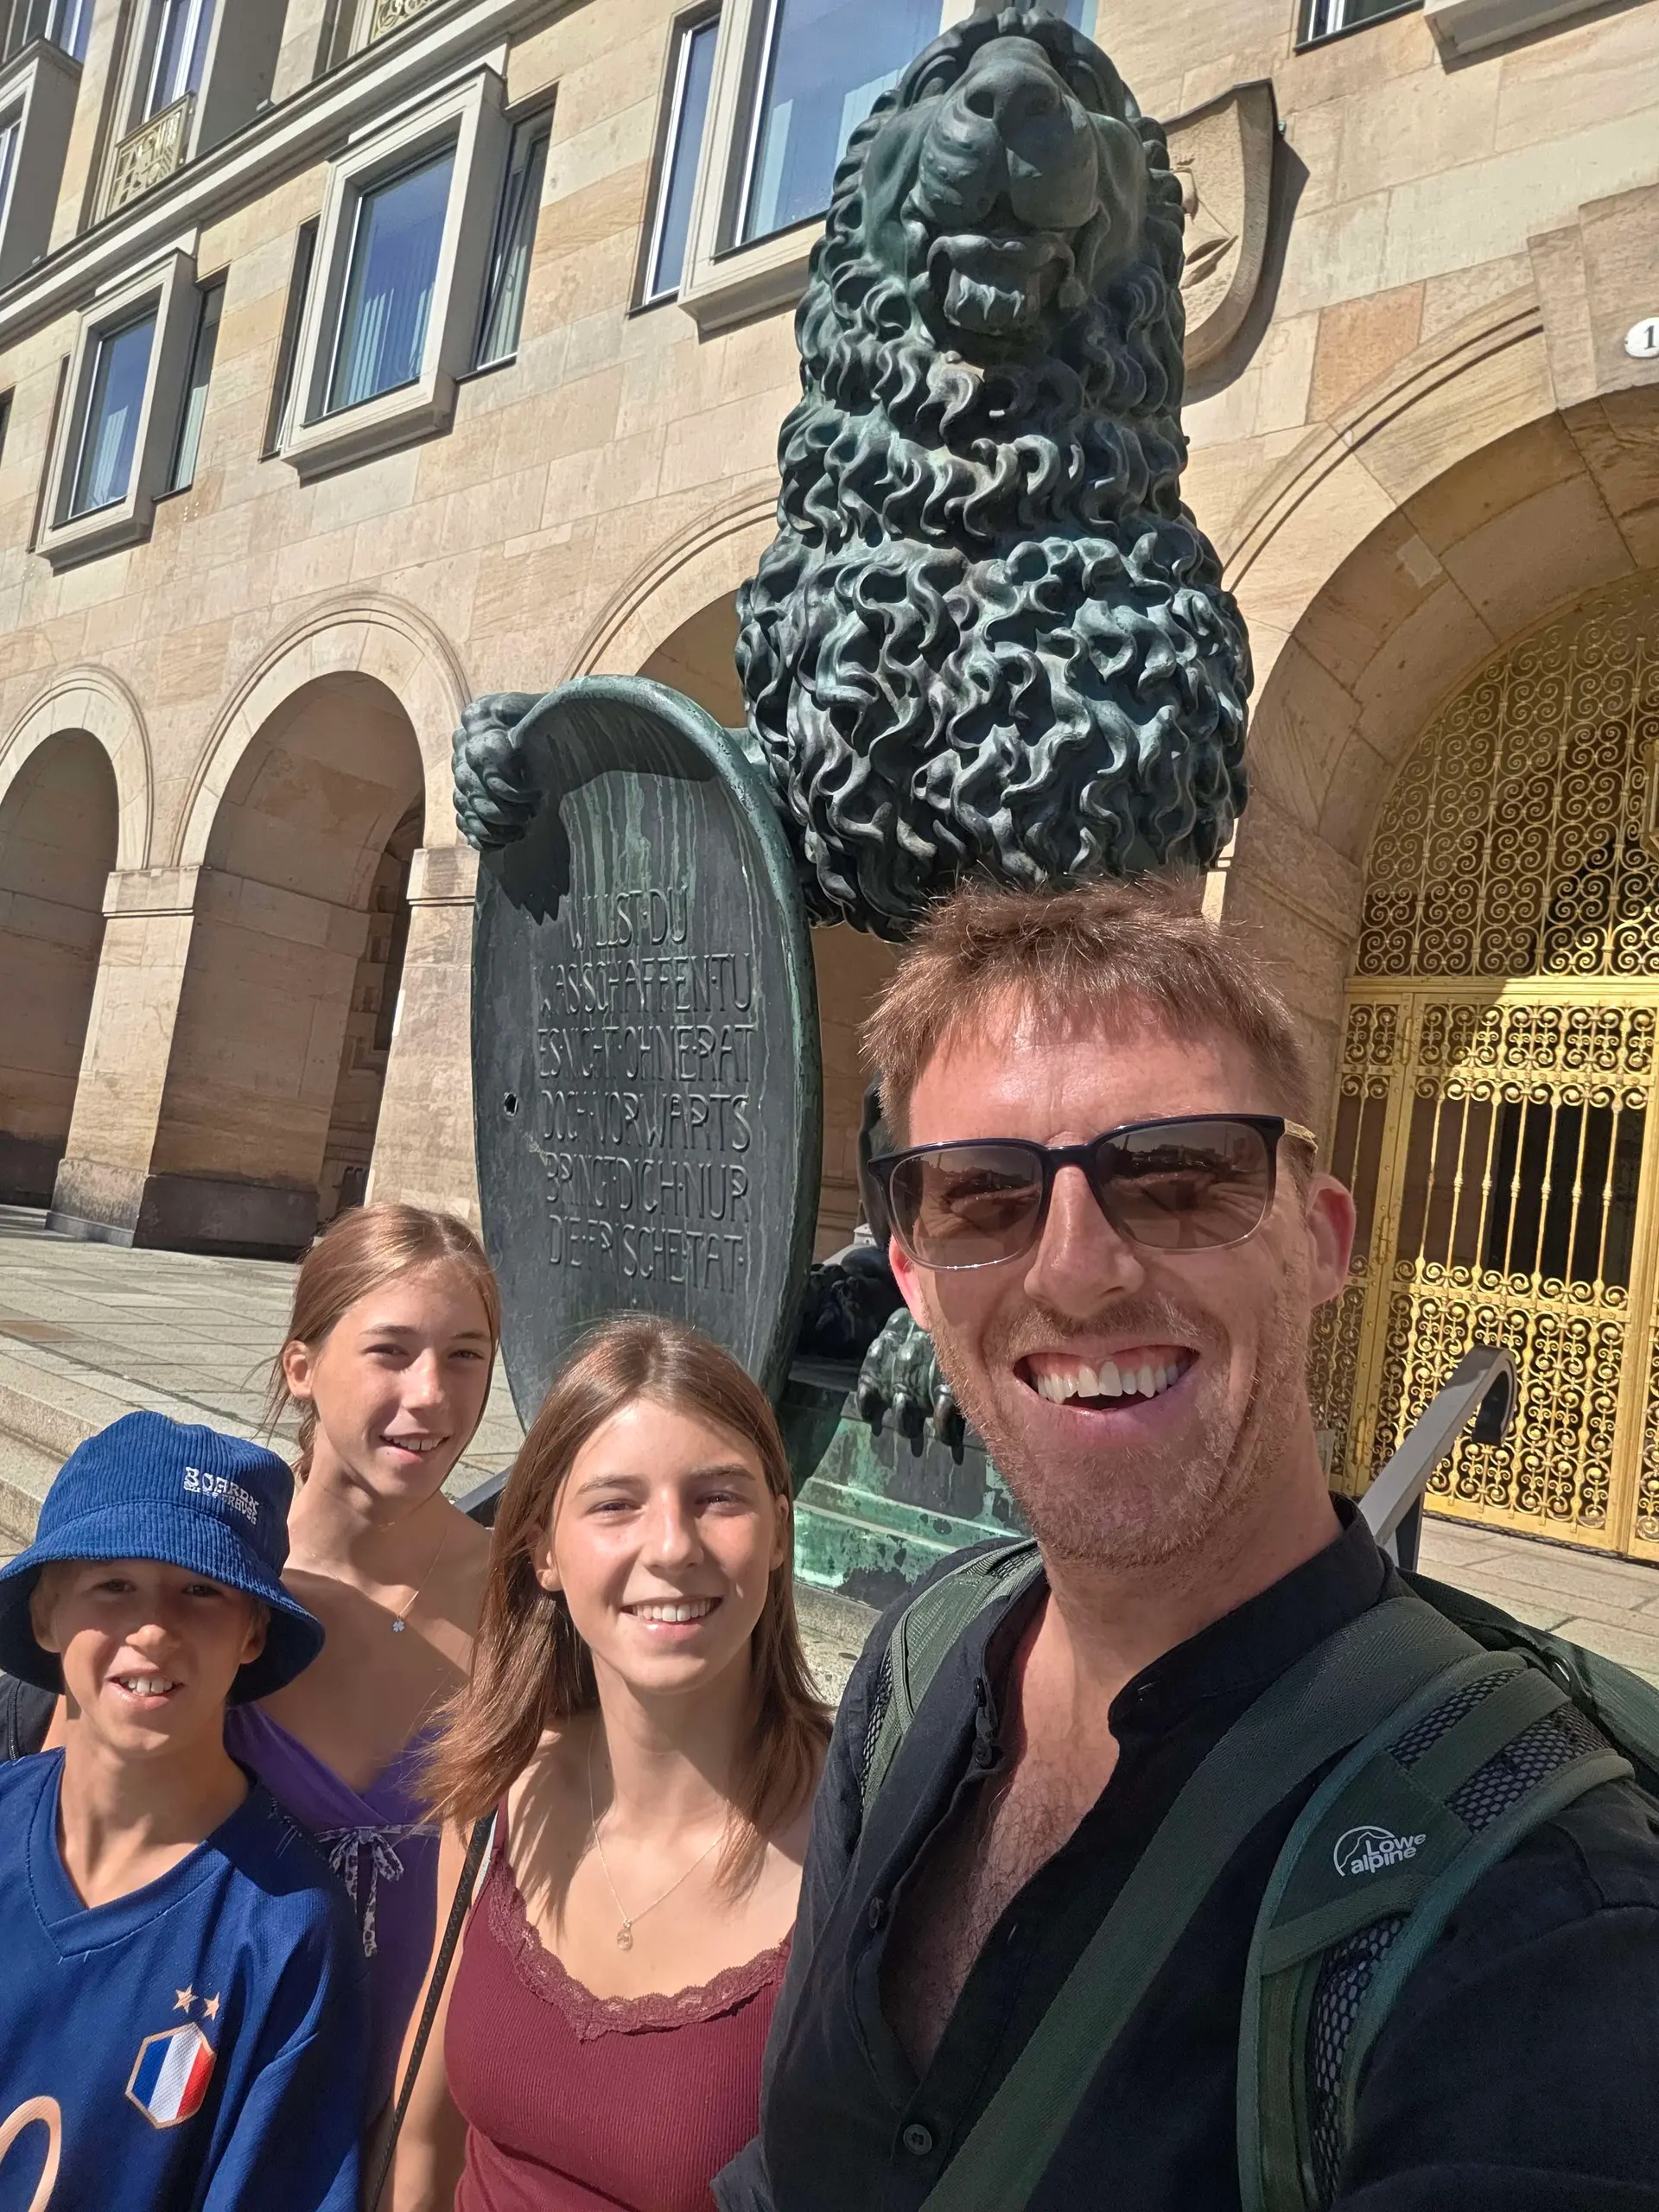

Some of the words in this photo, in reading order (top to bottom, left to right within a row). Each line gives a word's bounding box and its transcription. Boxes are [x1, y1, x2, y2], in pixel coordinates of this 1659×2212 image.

[650, 885, 689, 945] DU
[582, 956, 711, 1014] SCHAFFEN
[711, 953, 752, 1012] TU
[537, 1027, 561, 1078] ES
[625, 1026, 696, 1081] OHNE
[696, 1024, 756, 1082] RAT
[616, 1157, 679, 1216] DICH
[683, 1161, 750, 1222] NUR
[1351, 1847, 1417, 1874] alpine
[1365, 1834, 1427, 1856] Lowe
